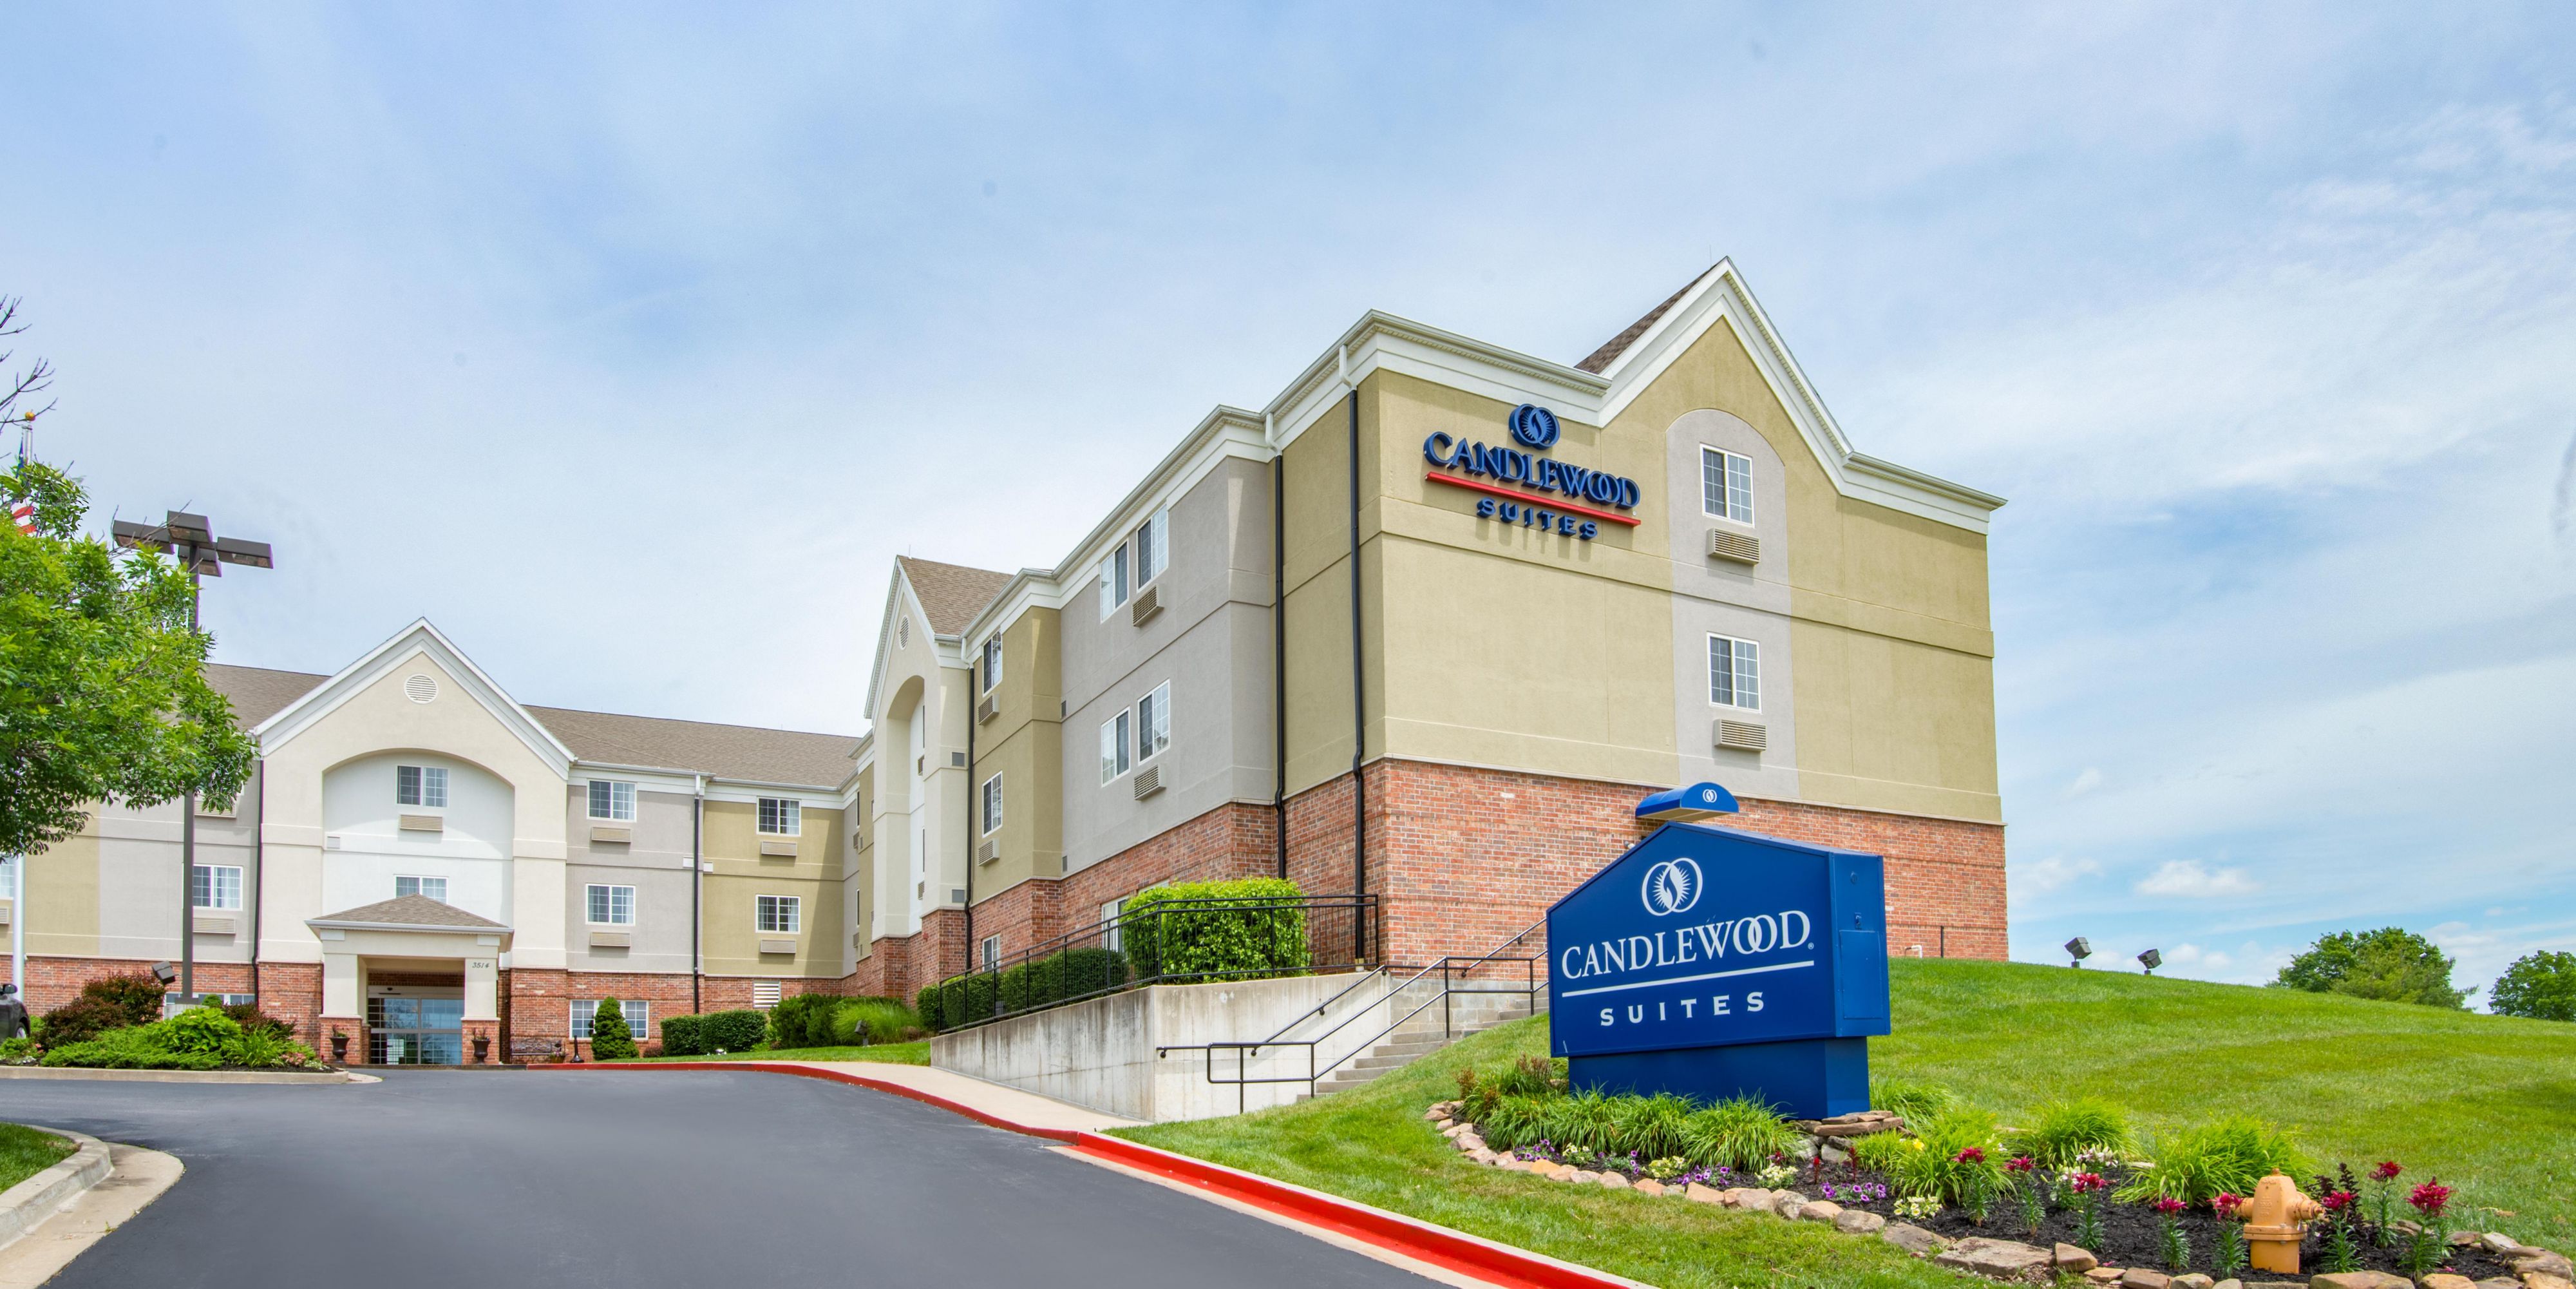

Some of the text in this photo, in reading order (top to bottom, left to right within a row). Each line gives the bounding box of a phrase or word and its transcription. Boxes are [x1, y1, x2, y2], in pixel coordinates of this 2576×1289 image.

[1423, 431, 1640, 510] CANDLEWOOD
[1477, 497, 1598, 540] SUITES
[1562, 910, 1810, 979] CANDLEWOOD
[1600, 991, 1765, 1026] SUITES
